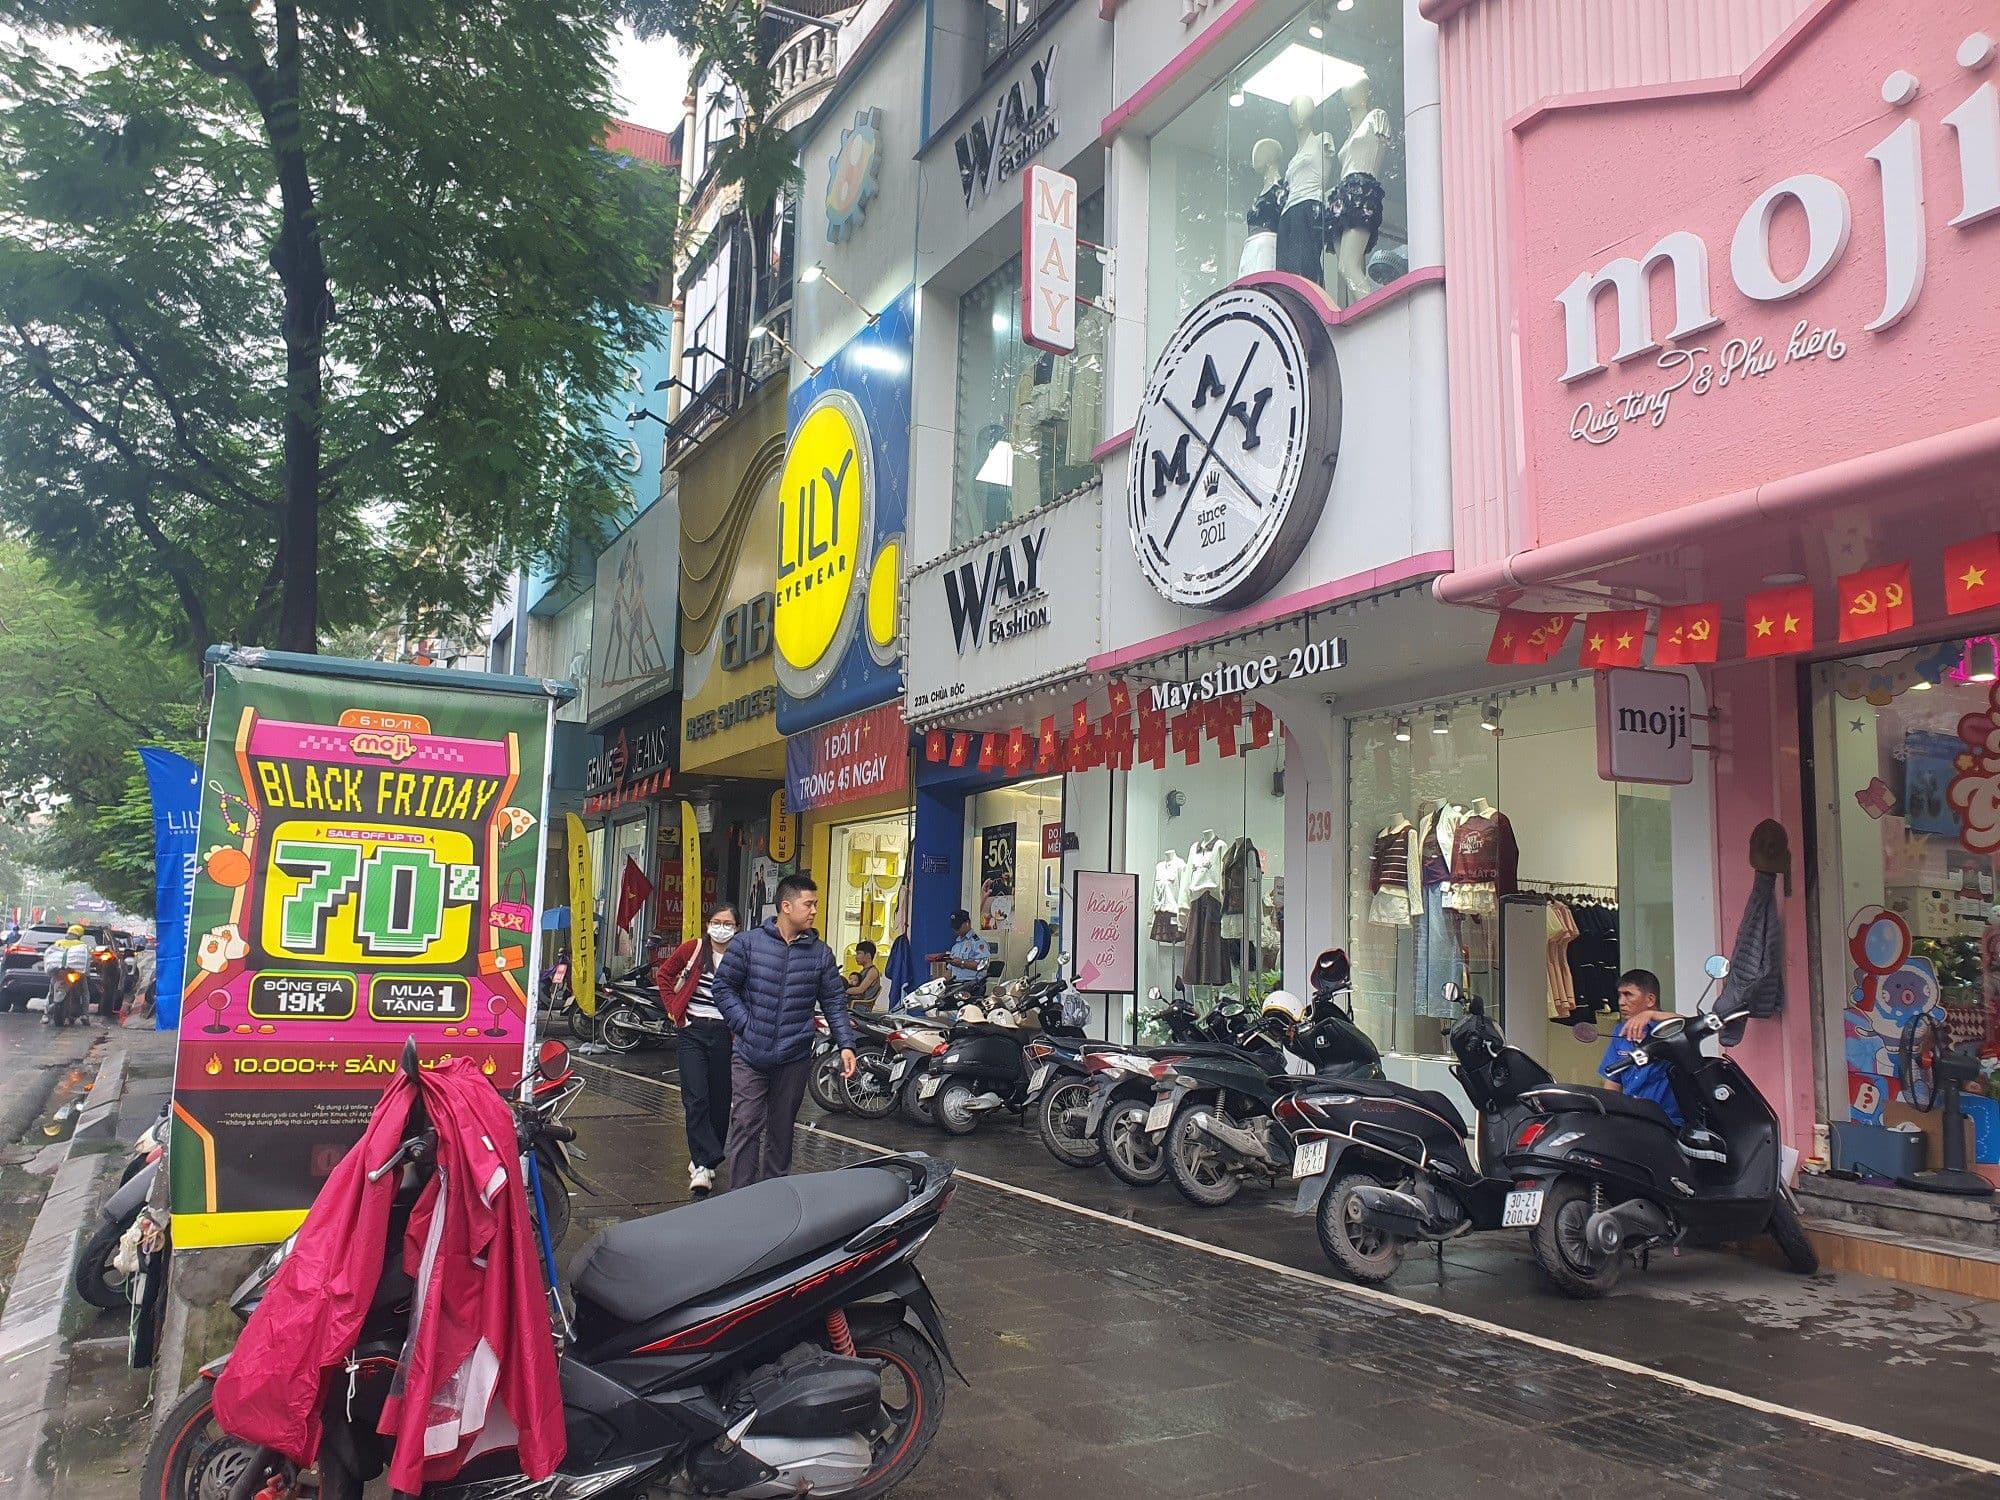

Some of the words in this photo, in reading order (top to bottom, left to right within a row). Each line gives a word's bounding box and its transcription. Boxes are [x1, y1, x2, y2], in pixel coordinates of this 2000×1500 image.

[1554, 32, 2000, 384] moji
[1038, 179, 1074, 332] MAY
[1569, 401, 1619, 444] Quà
[1616, 348, 1709, 427] tặng
[1692, 365, 1714, 394] &
[1719, 336, 1777, 386] Phụ
[1785, 320, 1847, 364] kiện
[777, 448, 853, 580] LILY
[1197, 502, 1227, 526] since
[1200, 522, 1226, 548] 2011
[776, 555, 846, 608] EYEWEAR
[1288, 637, 1346, 679] 2011
[914, 693, 929, 707] 237A
[931, 685, 949, 702] CHÙA
[382, 718, 412, 730] 10/11
[686, 709, 717, 741] BEE
[718, 685, 777, 730] SHOES
[1618, 704, 1688, 750] moji
[354, 734, 411, 759] moji
[632, 726, 666, 773] JEANS
[831, 723, 851, 759] ĐỔI
[800, 770, 834, 800] TRONG
[837, 766, 850, 791] 45
[853, 753, 887, 788] NGÀY
[257, 762, 362, 813] BLACK
[377, 772, 498, 821] FRIDAY
[168, 811, 200, 829] LIL
[1308, 811, 1331, 842] 239
[328, 830, 358, 839] SALE
[361, 831, 385, 840] OFF
[387, 832, 405, 841] UP
[407, 833, 424, 843] TO
[778, 838, 786, 859] BEE
[1086, 891, 1128, 921] hàng
[1090, 922, 1121, 941] mới
[1096, 945, 1116, 966] về
[264, 979, 314, 992] ĐỒNG
[317, 981, 343, 992] GIÁ
[391, 984, 434, 997] MUA
[278, 993, 326, 1012] 19K
[382, 997, 434, 1013] TẶNG
[438, 986, 456, 1012] 1
[234, 1058, 338, 1073] 10.000++
[345, 1054, 396, 1073] SẢN
[1510, 1193, 1537, 1208] 30-Z1
